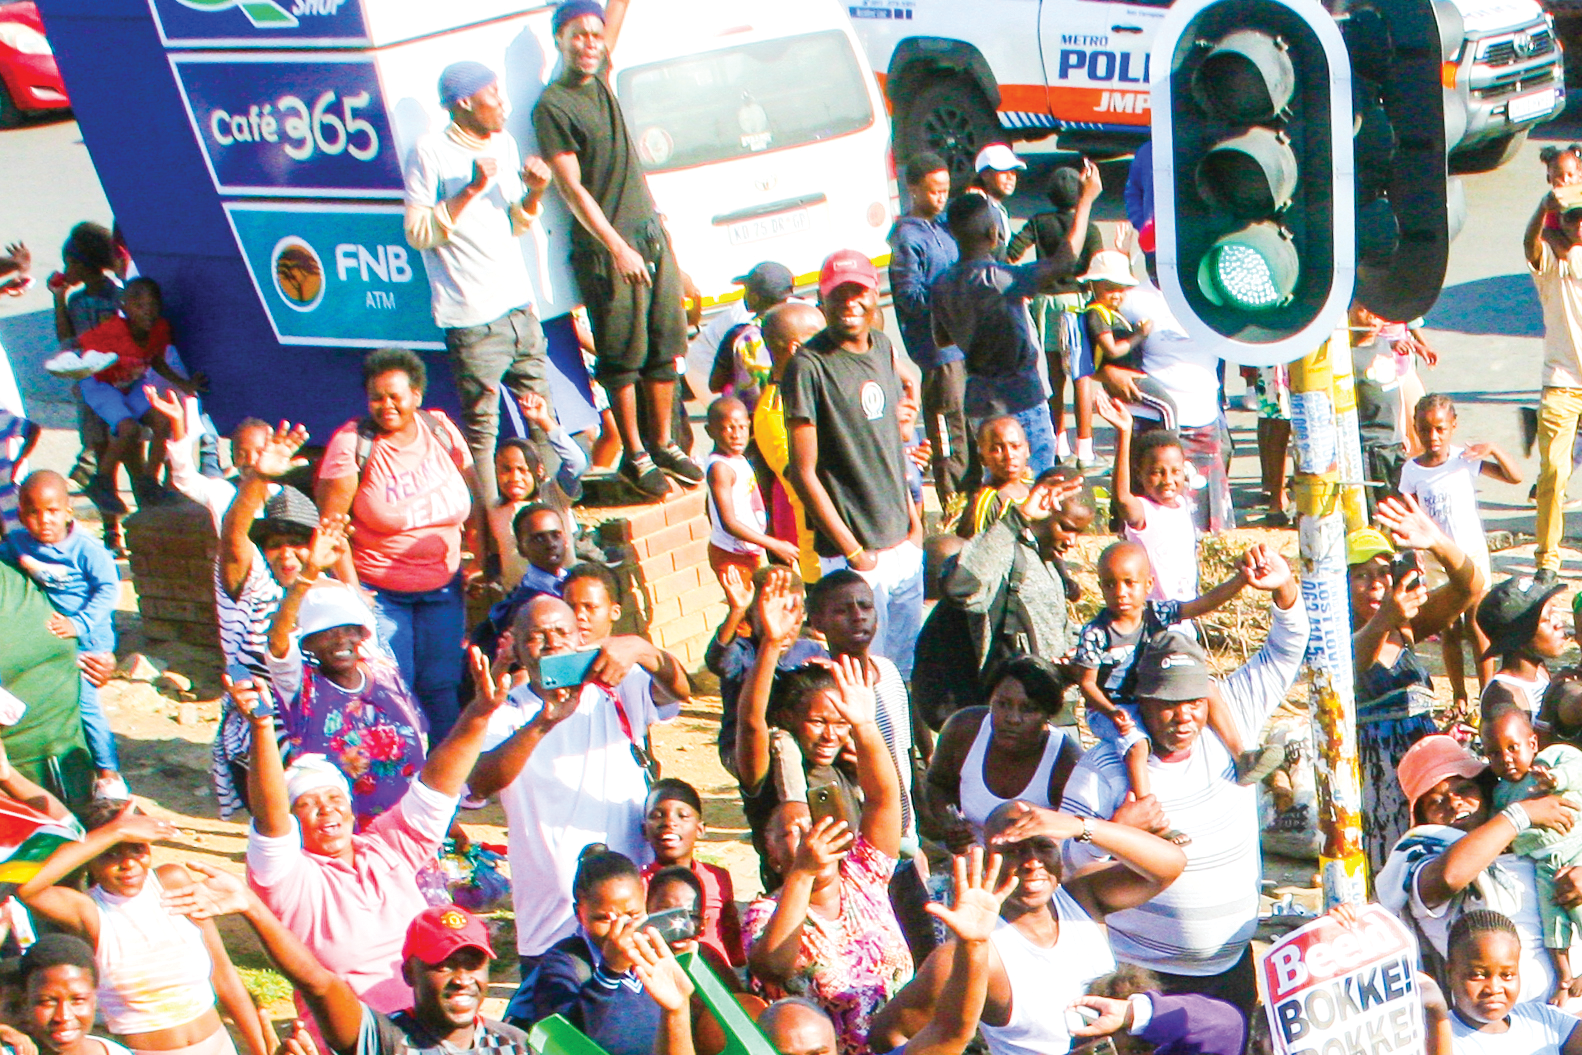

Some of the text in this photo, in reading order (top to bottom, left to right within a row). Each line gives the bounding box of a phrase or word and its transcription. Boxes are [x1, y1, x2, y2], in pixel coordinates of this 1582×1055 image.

[1061, 34, 1109, 47] METRO
[210, 91, 379, 161] Café 365
[335, 243, 413, 282] FNB
[365, 291, 396, 310] ATM
[1277, 955, 1413, 1044] BOKKE!
